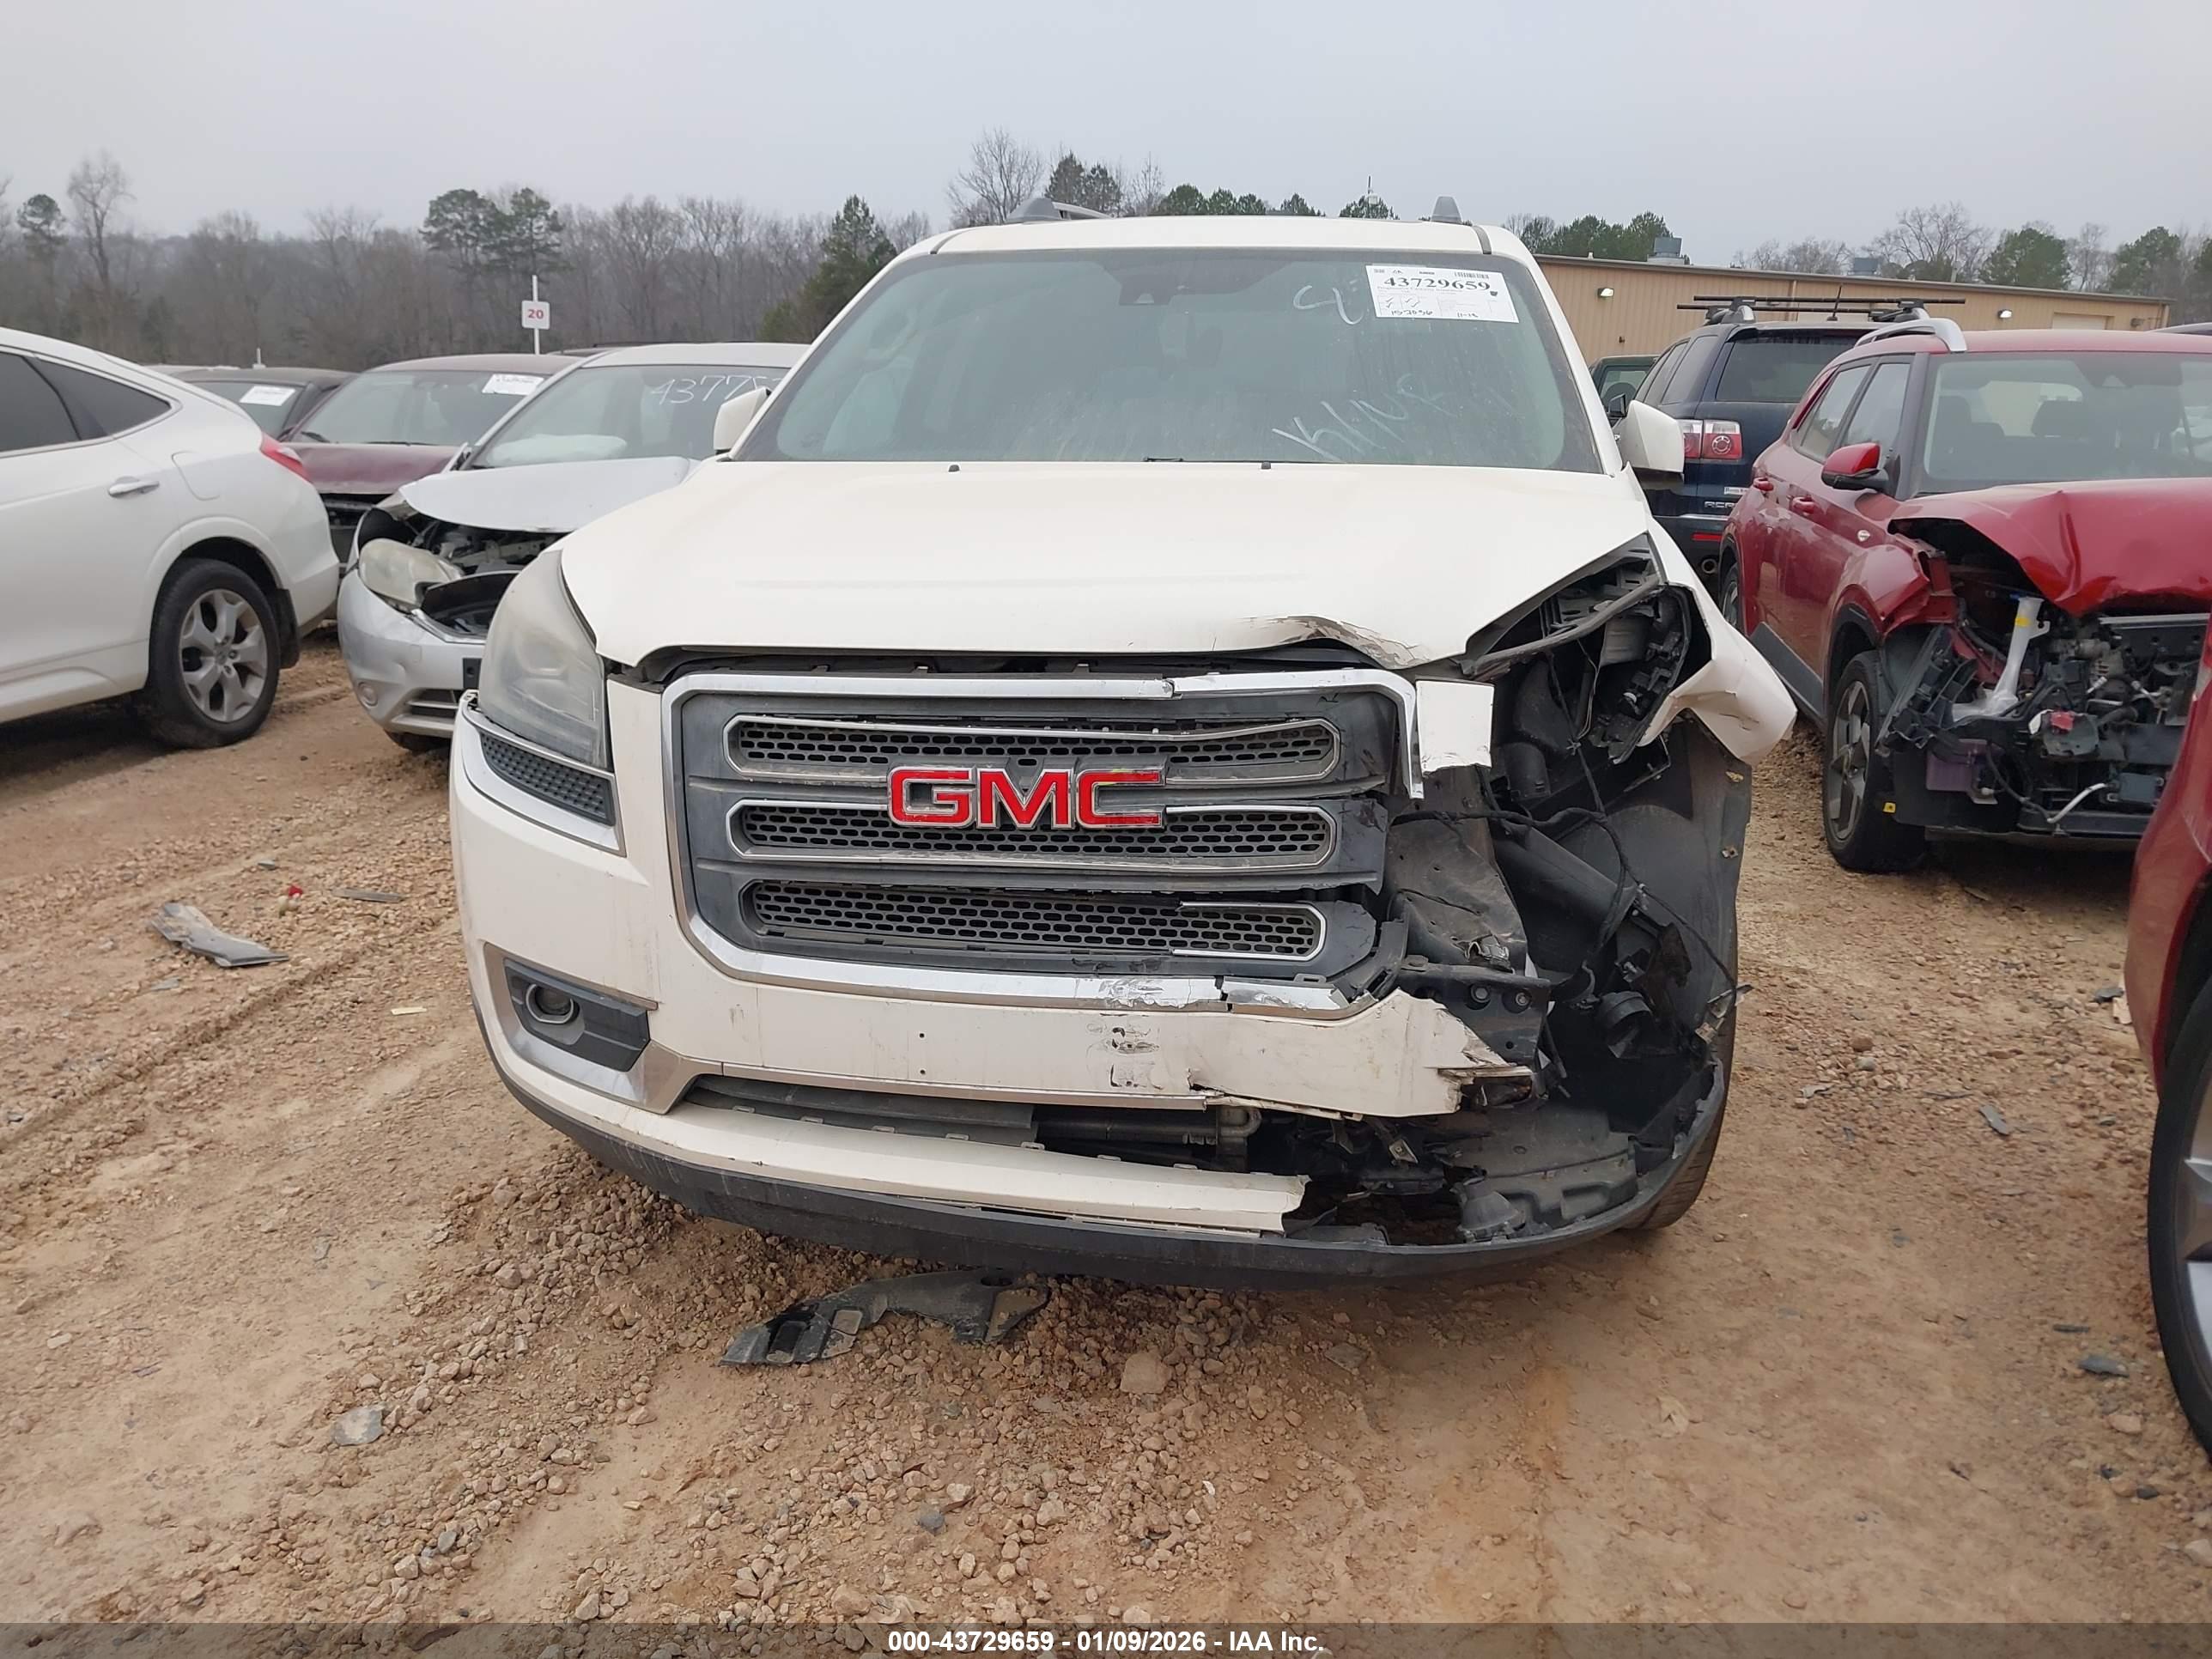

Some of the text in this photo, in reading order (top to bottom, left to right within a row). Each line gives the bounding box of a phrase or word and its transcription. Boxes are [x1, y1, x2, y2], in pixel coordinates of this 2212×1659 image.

[1383, 276, 1492, 292] 43729659
[527, 309, 544, 319] 20
[888, 766, 1165, 830] GMC
